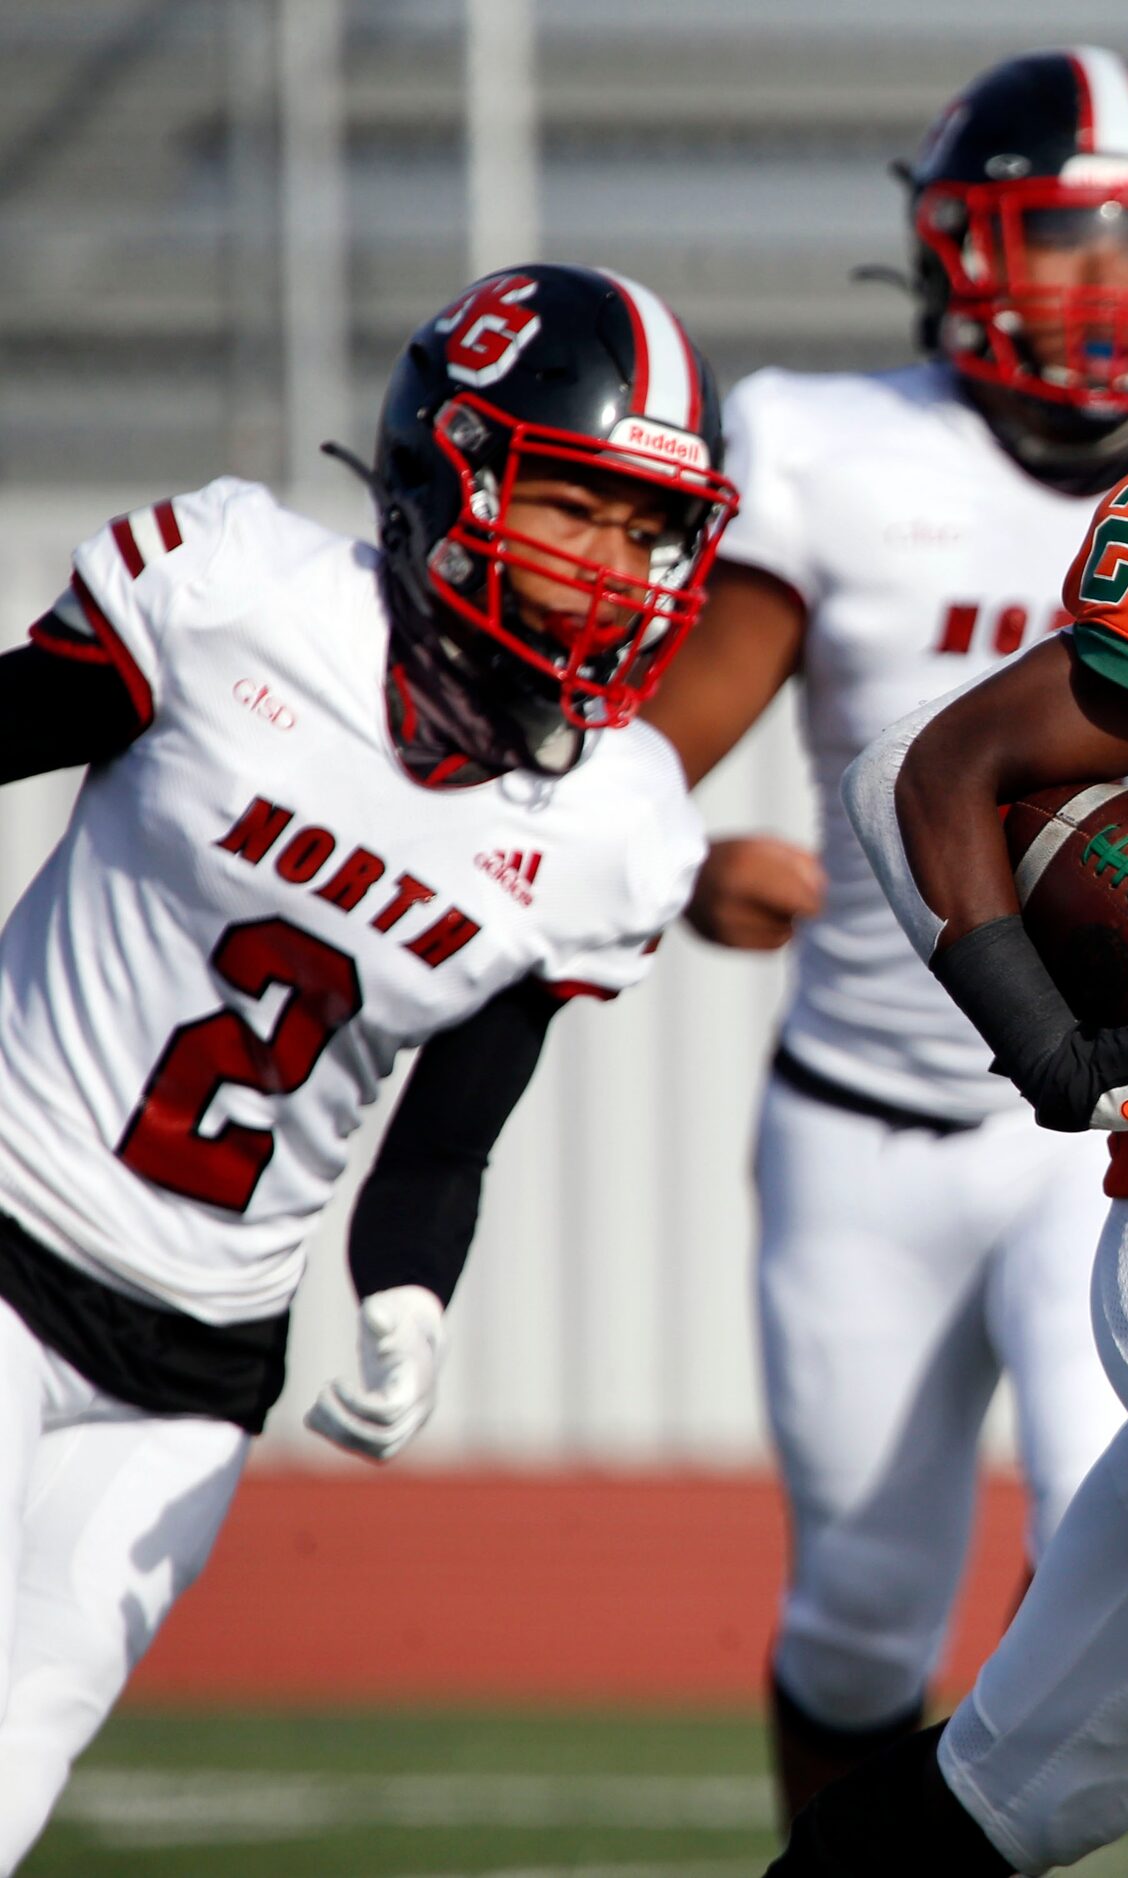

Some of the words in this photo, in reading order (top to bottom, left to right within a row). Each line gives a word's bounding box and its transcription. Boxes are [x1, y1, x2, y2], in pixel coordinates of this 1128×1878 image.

[629, 425, 701, 463] Riddell
[213, 795, 482, 968] NORTH
[114, 914, 364, 1214] 2
